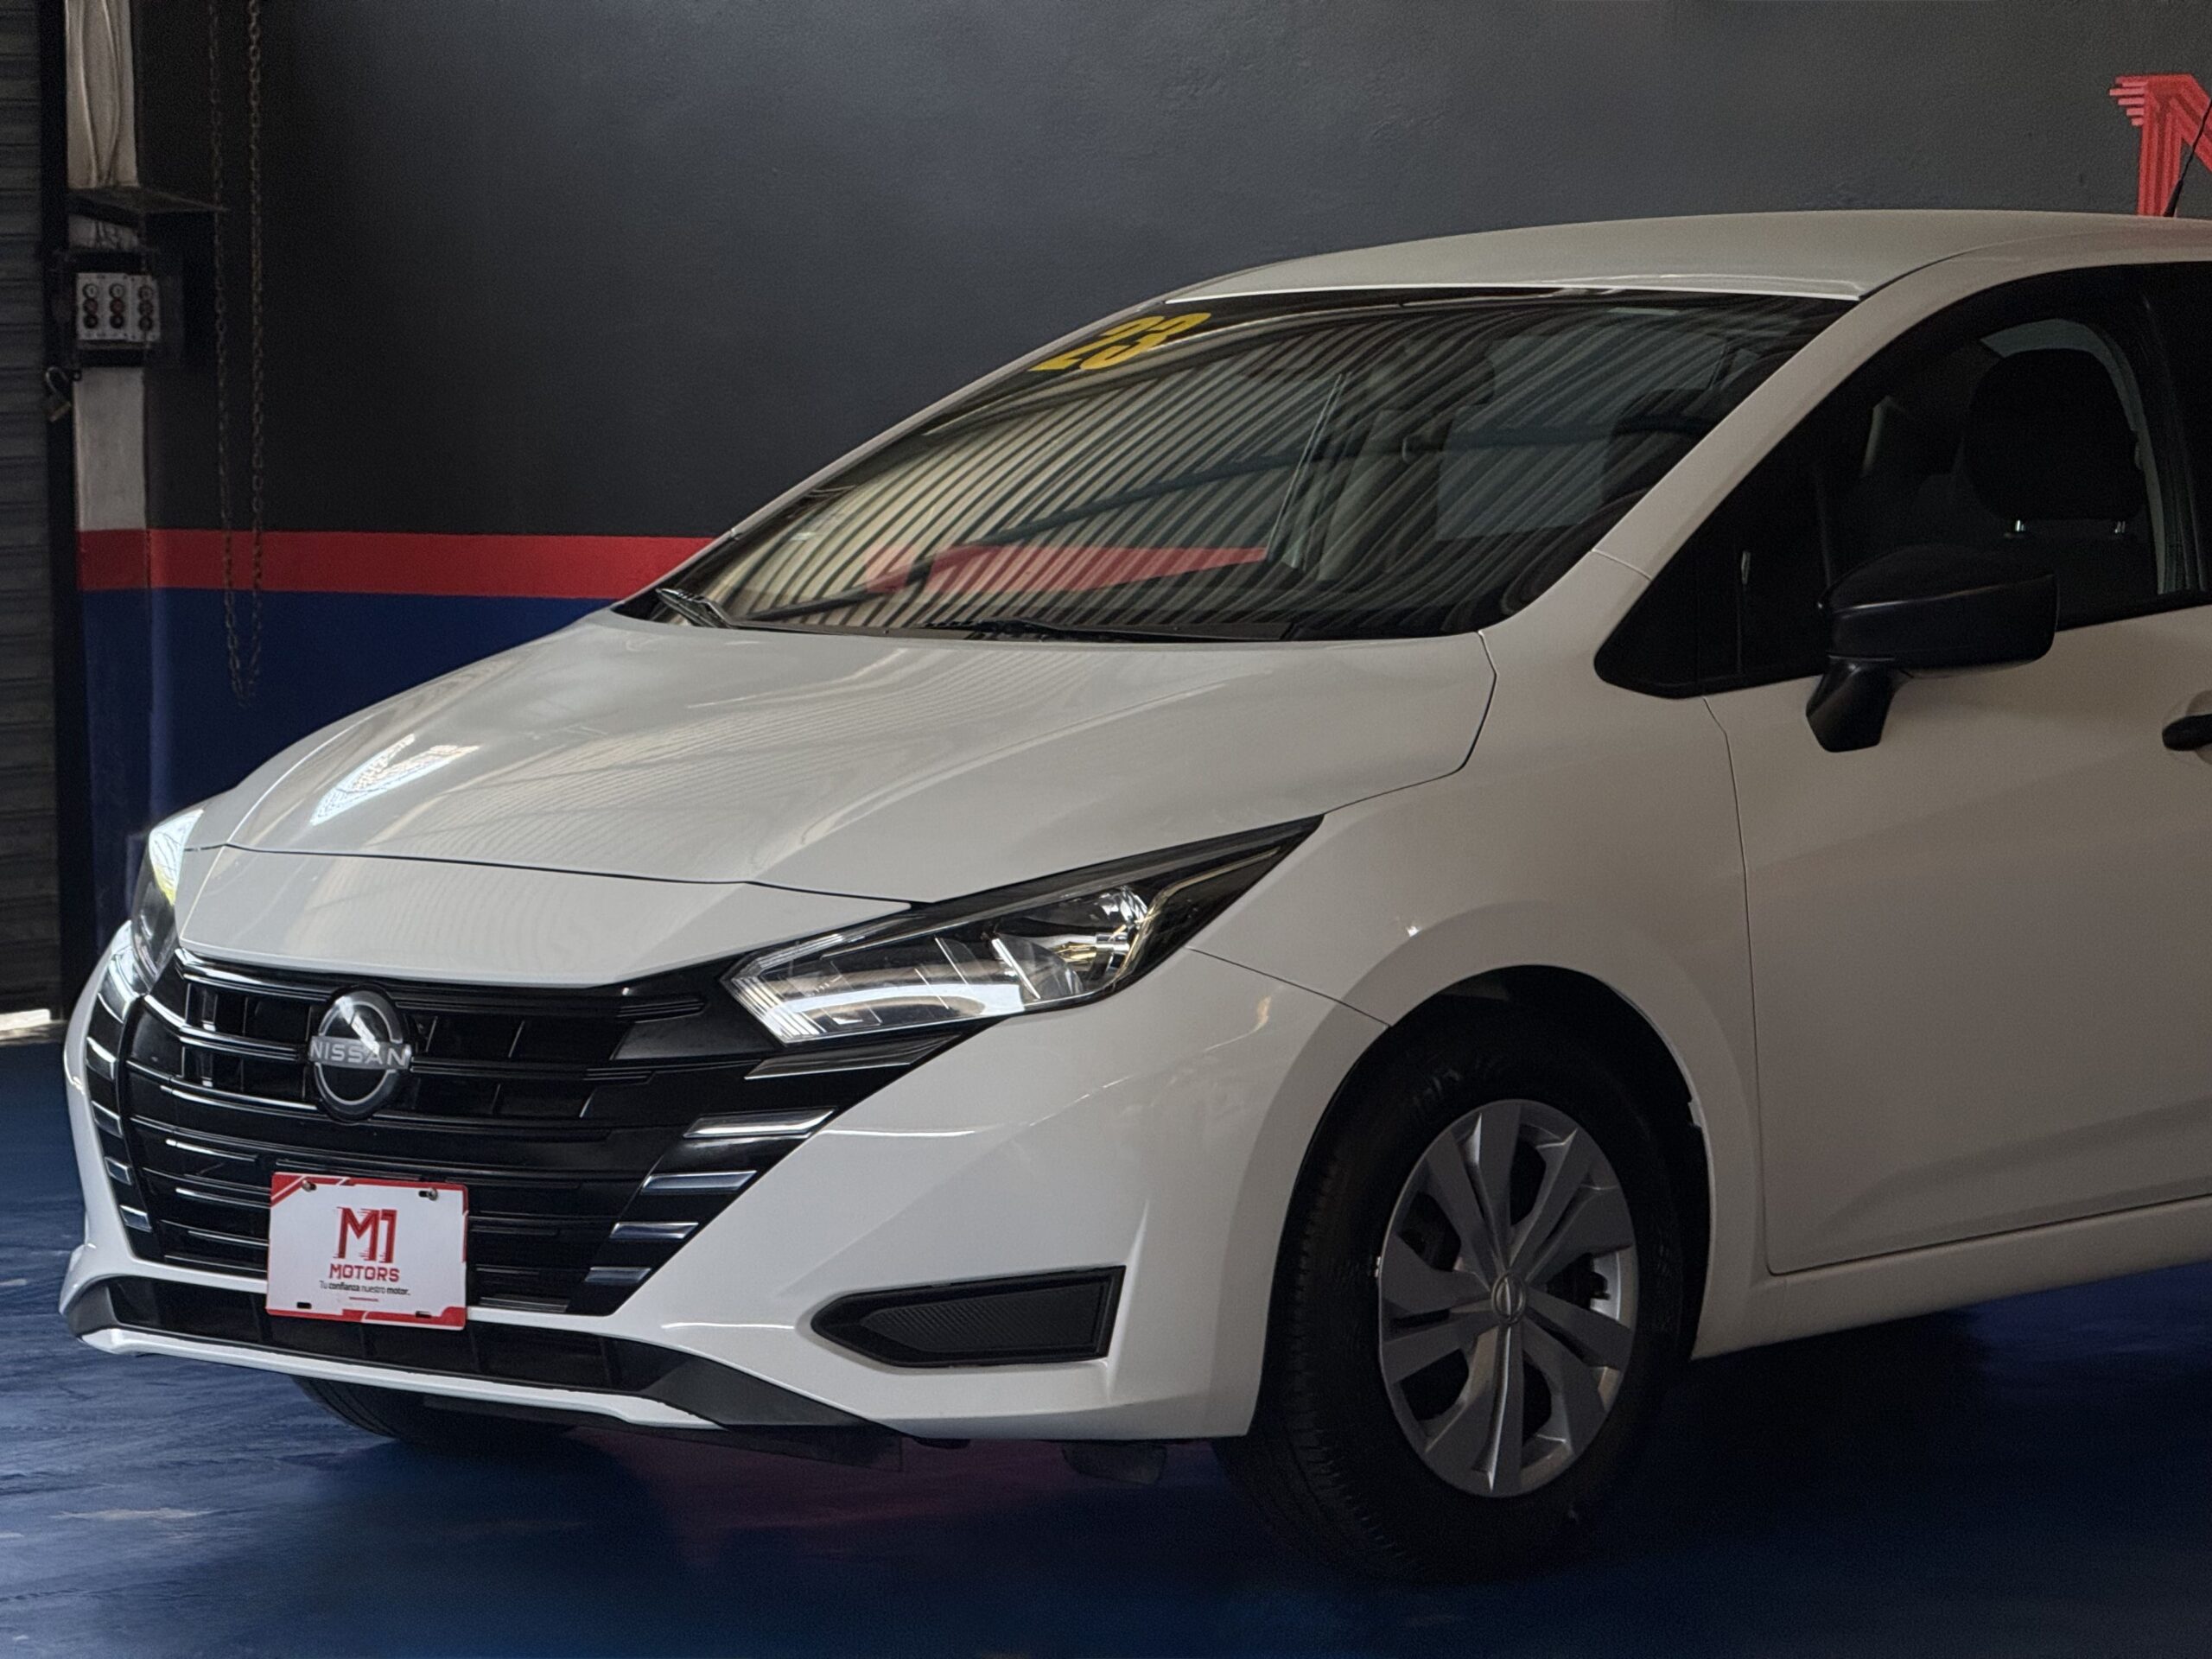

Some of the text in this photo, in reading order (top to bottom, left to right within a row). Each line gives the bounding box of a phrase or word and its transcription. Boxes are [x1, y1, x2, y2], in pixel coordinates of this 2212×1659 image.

[1027, 312, 1211, 372] 23
[309, 1039, 406, 1066] NISSAN
[329, 1263, 400, 1283] MOTORS
[319, 1280, 327, 1289] Tu
[328, 1281, 360, 1292] confianza
[360, 1285, 385, 1294] nuestro
